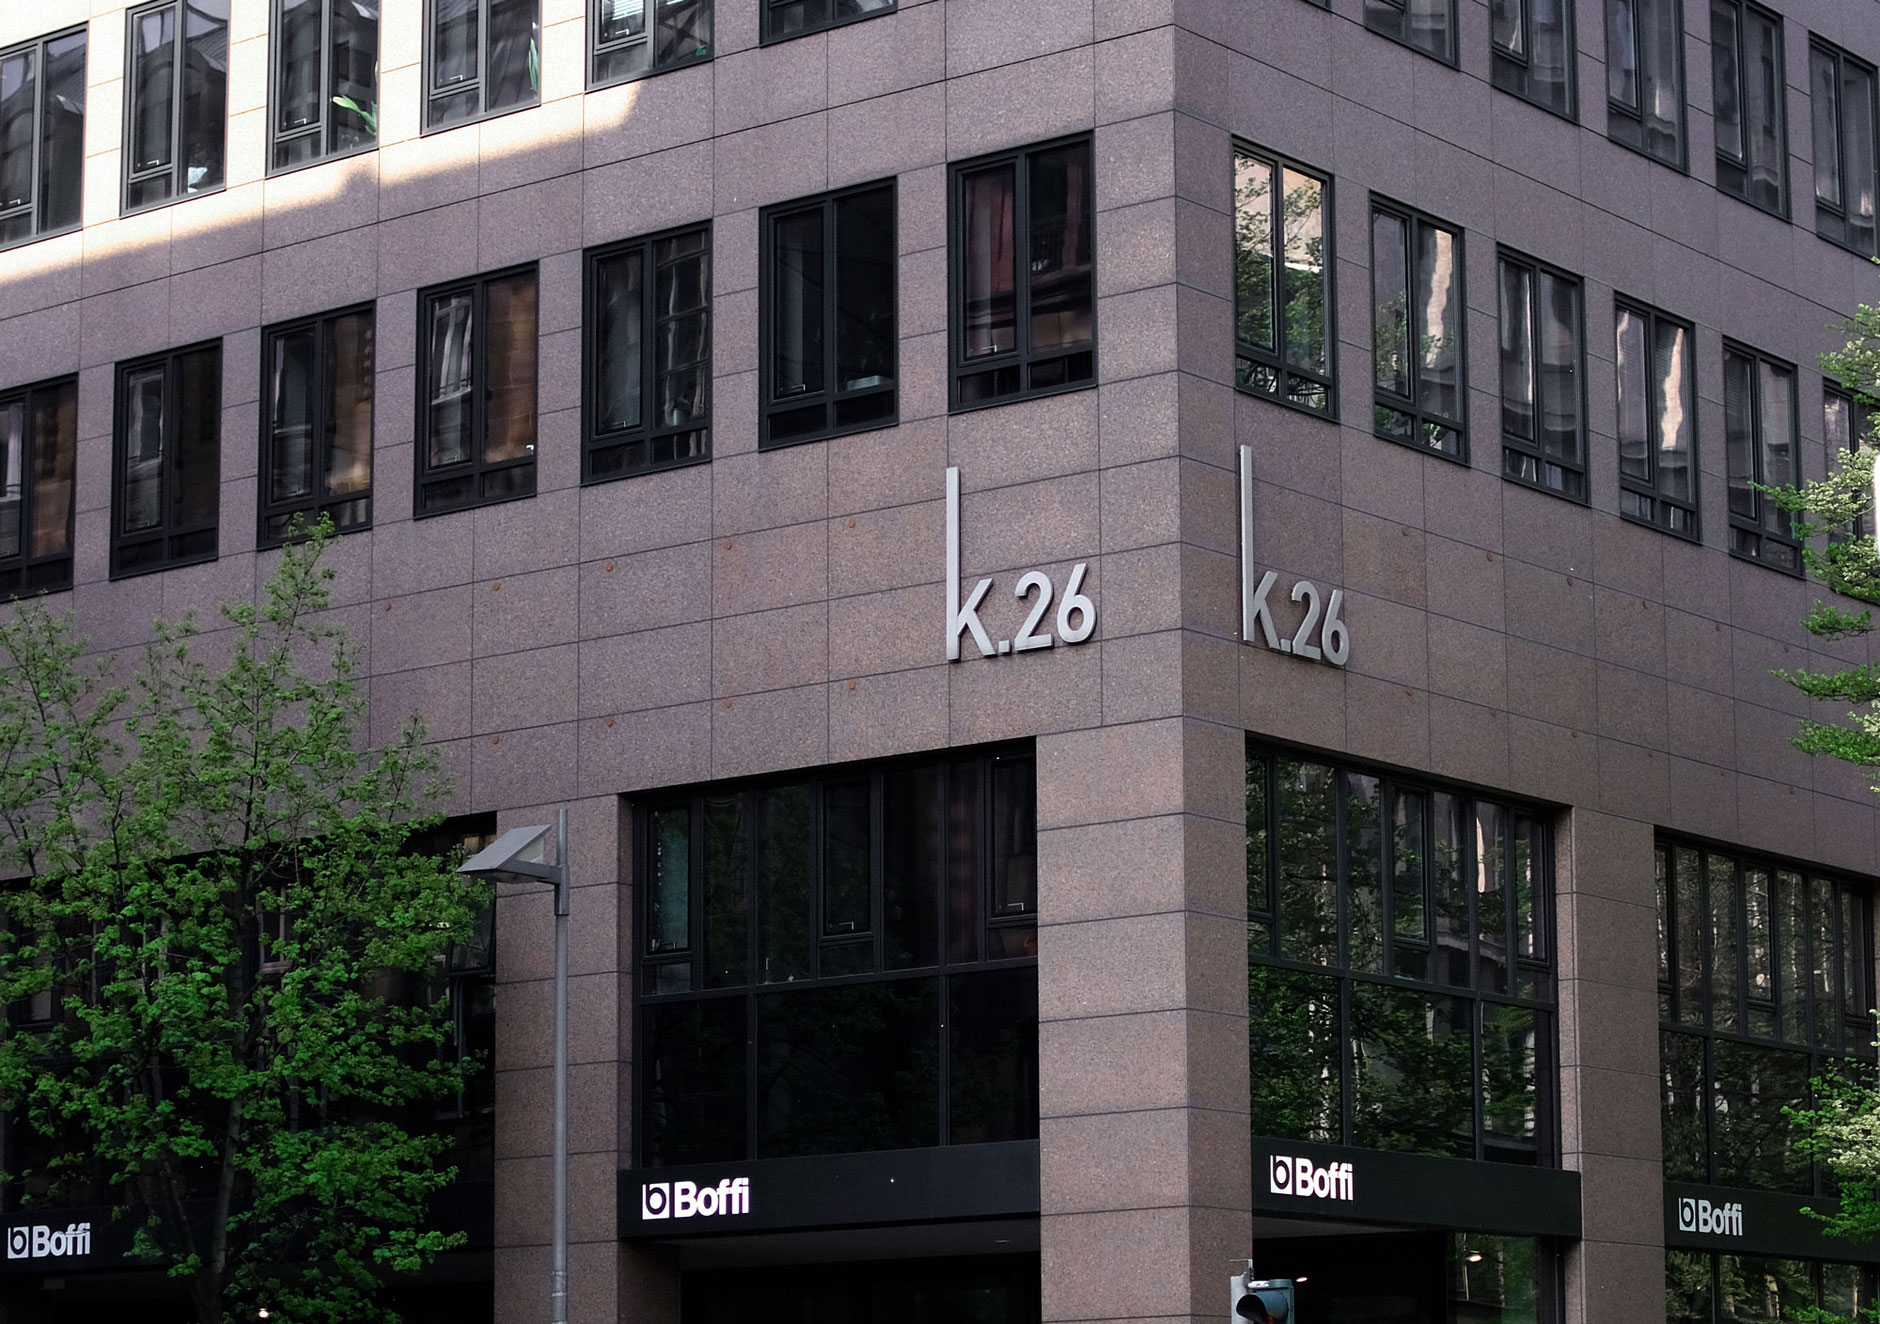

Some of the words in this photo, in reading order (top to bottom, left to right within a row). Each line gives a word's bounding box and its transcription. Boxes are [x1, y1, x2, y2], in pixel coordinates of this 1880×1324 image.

[674, 1177, 749, 1218] Boffi
[1295, 1157, 1354, 1201] Boffi
[1698, 1199, 1743, 1236] Boffi
[32, 1222, 91, 1257] Boffi
